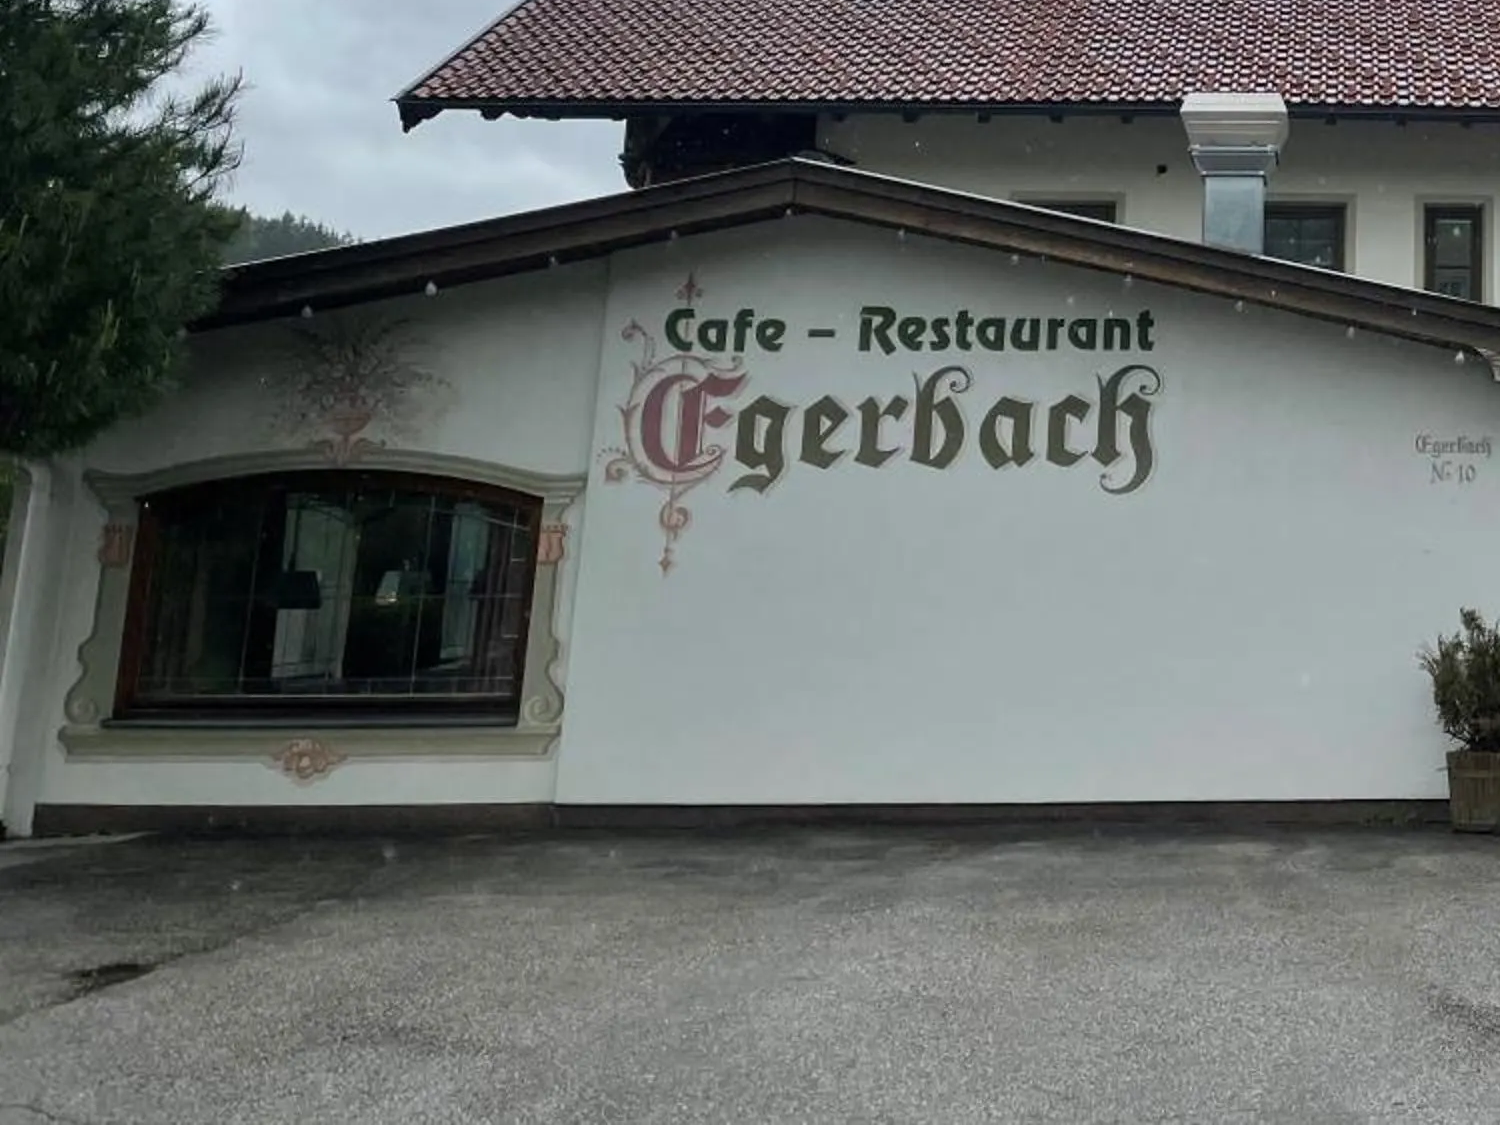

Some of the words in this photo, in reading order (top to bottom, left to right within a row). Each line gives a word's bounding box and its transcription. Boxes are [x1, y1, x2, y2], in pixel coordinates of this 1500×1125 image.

[665, 308, 787, 352] Cafe
[857, 306, 1156, 355] Restaurant
[639, 364, 1161, 495] Egerbach
